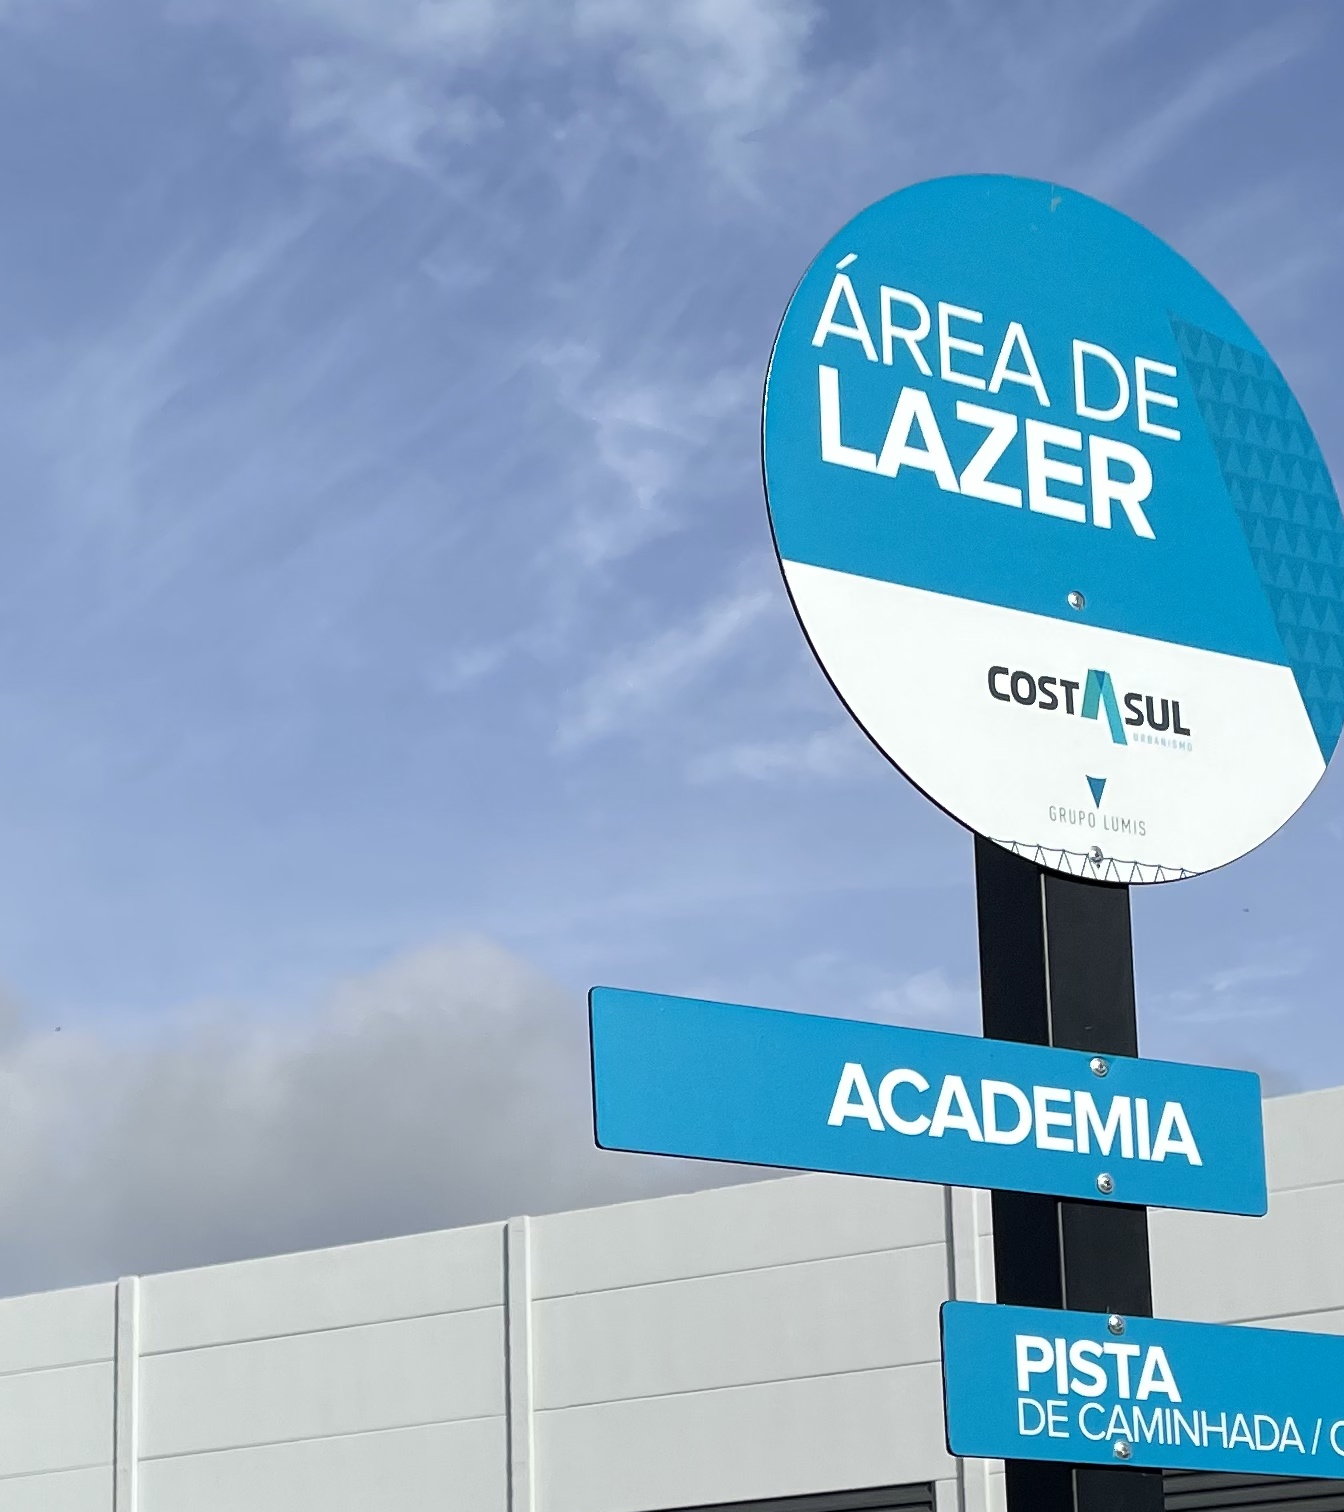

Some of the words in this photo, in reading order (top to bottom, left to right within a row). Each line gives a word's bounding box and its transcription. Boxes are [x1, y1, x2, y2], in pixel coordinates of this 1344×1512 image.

[812, 253, 1050, 407] ÁREA
[1071, 338, 1181, 441] DE
[818, 364, 1156, 540] LAZER
[1133, 732, 1193, 752] URBANISMO
[1048, 805, 1096, 828] GRUPO
[1103, 814, 1147, 837] LUMIS
[827, 1062, 1203, 1166] ACADEMIA
[1015, 1334, 1182, 1403] PISTA
[1017, 1397, 1069, 1439] DE
[1078, 1402, 1306, 1456] CAMINHADA
